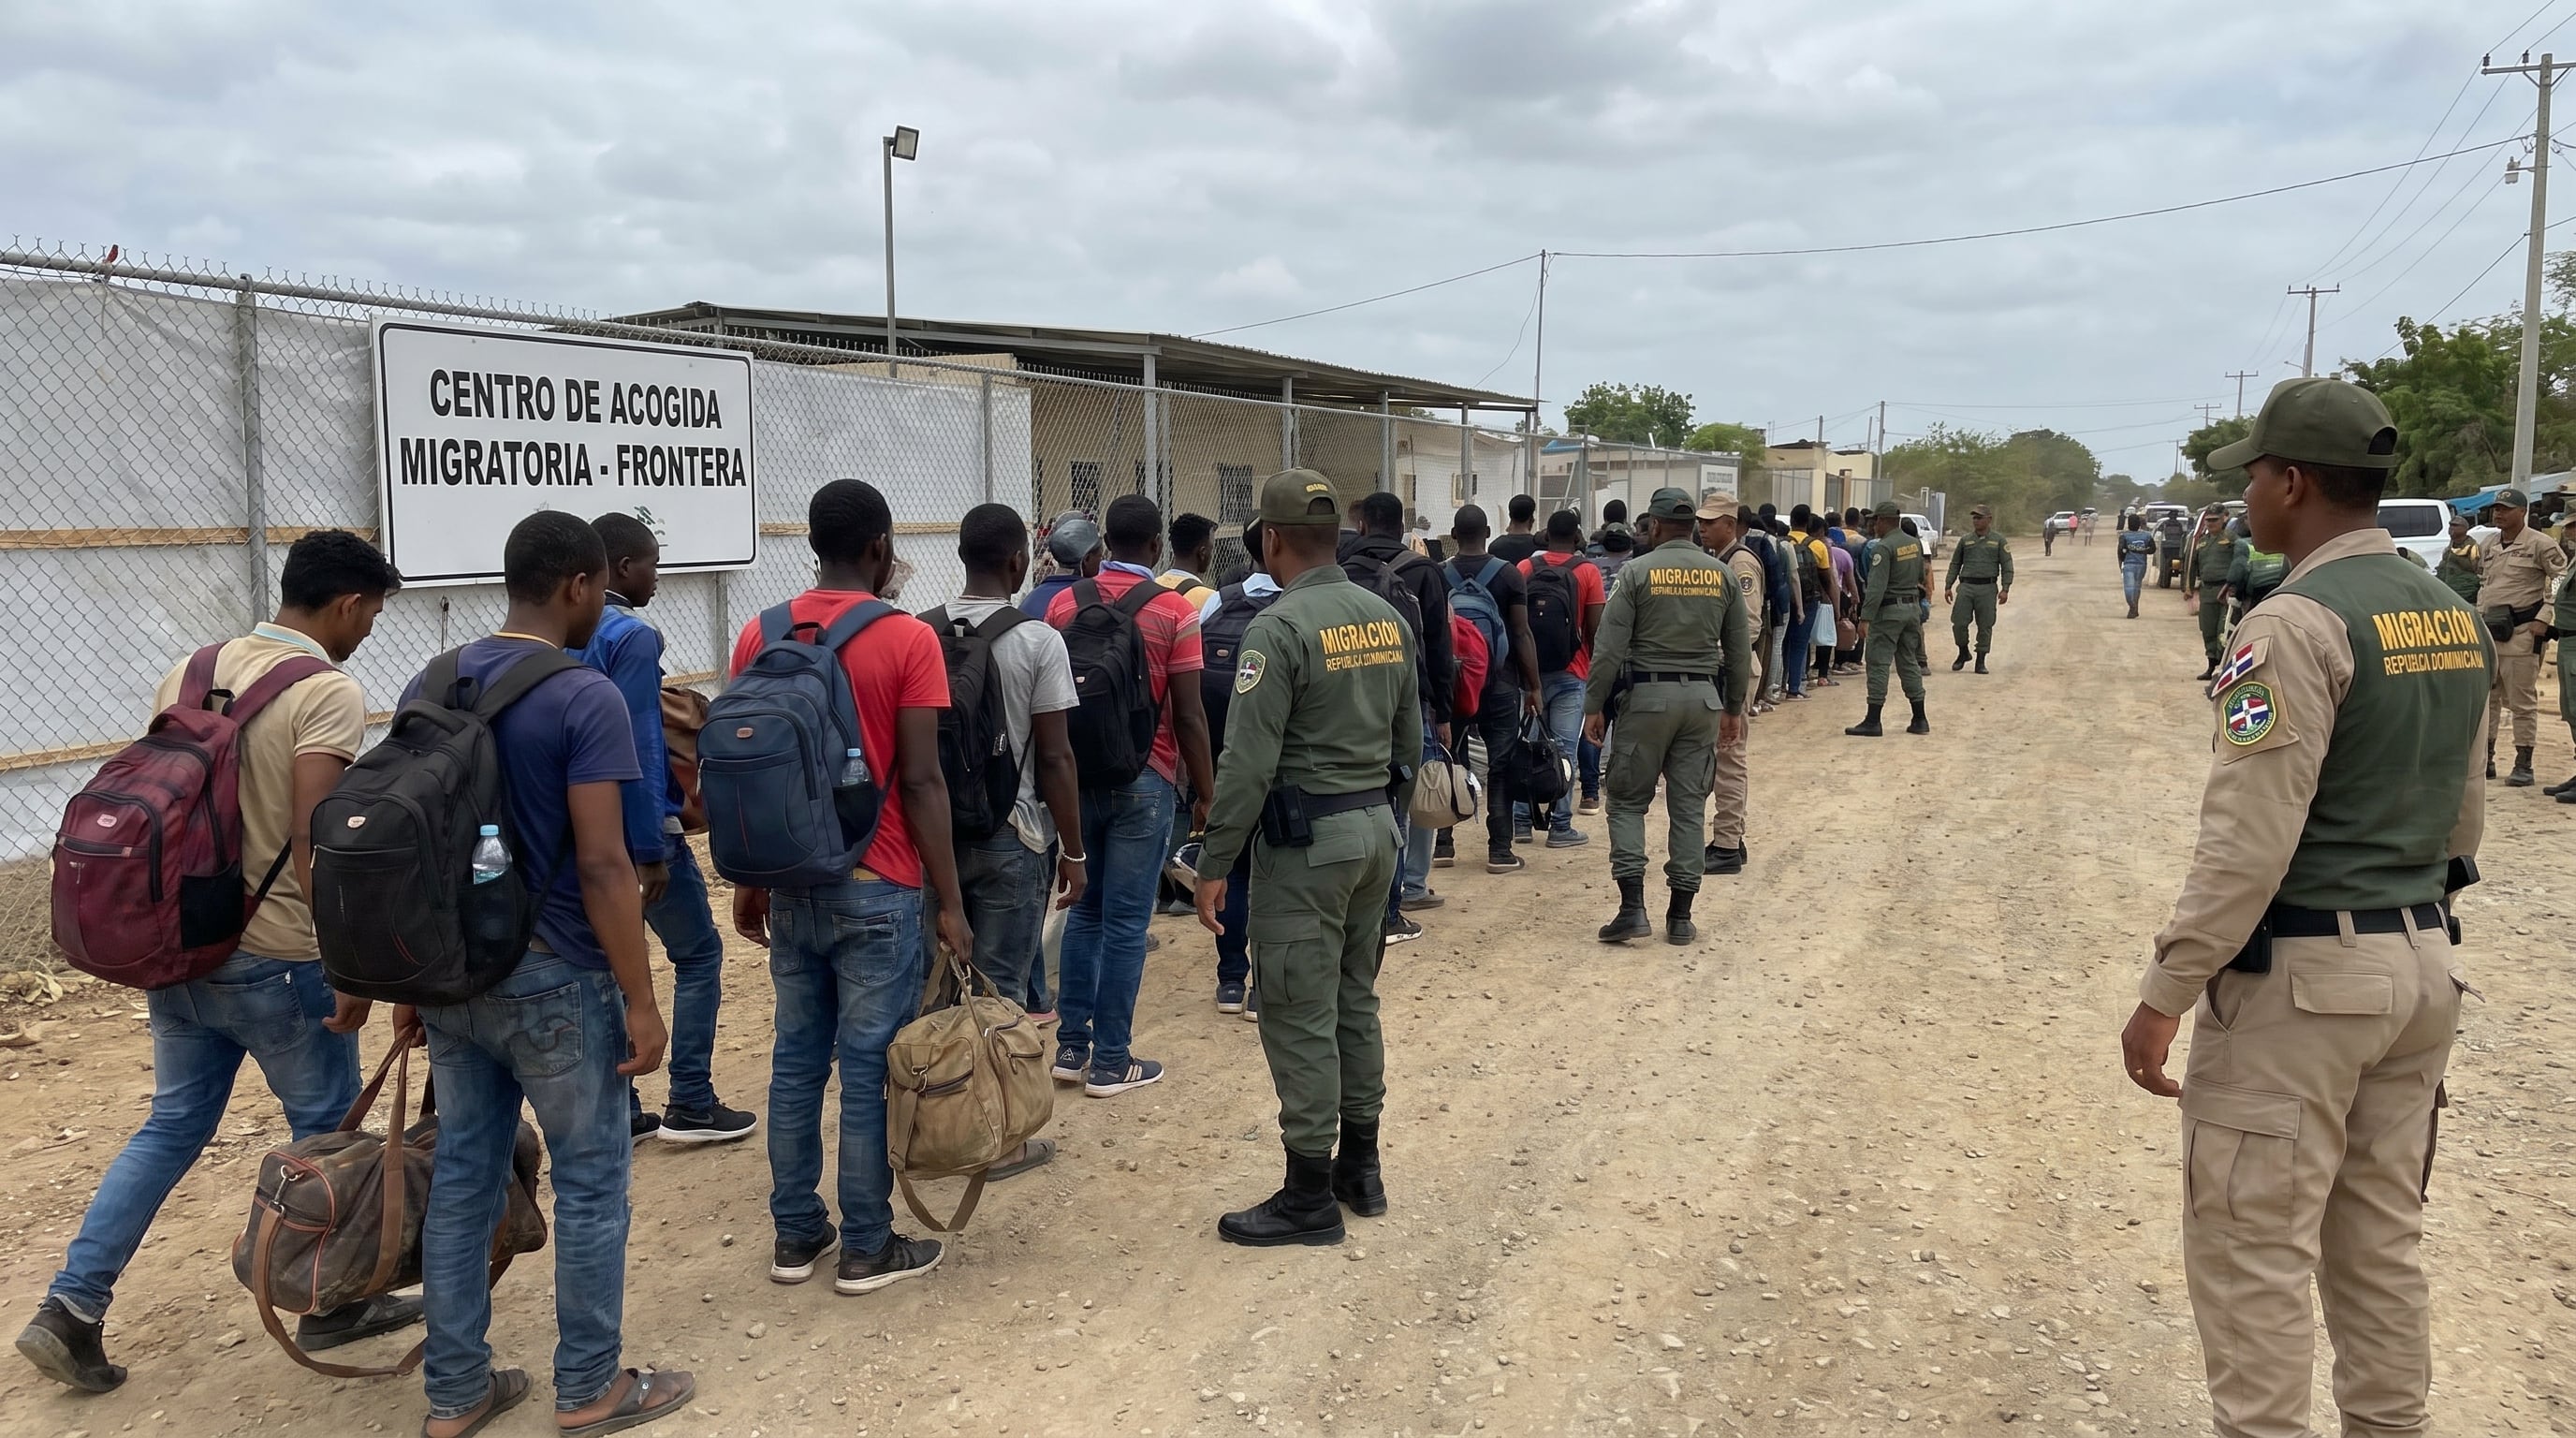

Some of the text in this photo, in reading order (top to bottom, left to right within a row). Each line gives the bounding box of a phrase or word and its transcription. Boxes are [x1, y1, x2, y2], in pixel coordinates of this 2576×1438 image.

[430, 369, 723, 429] CENTRO DE ACOGIDA
[400, 437, 593, 486] MIGRATORIA
[617, 445, 747, 487] FRONTERA
[1649, 568, 1721, 586] MIGRACION
[1319, 618, 1402, 655] MIGRACIÓN
[2372, 606, 2480, 651] MIGRACIÓN
